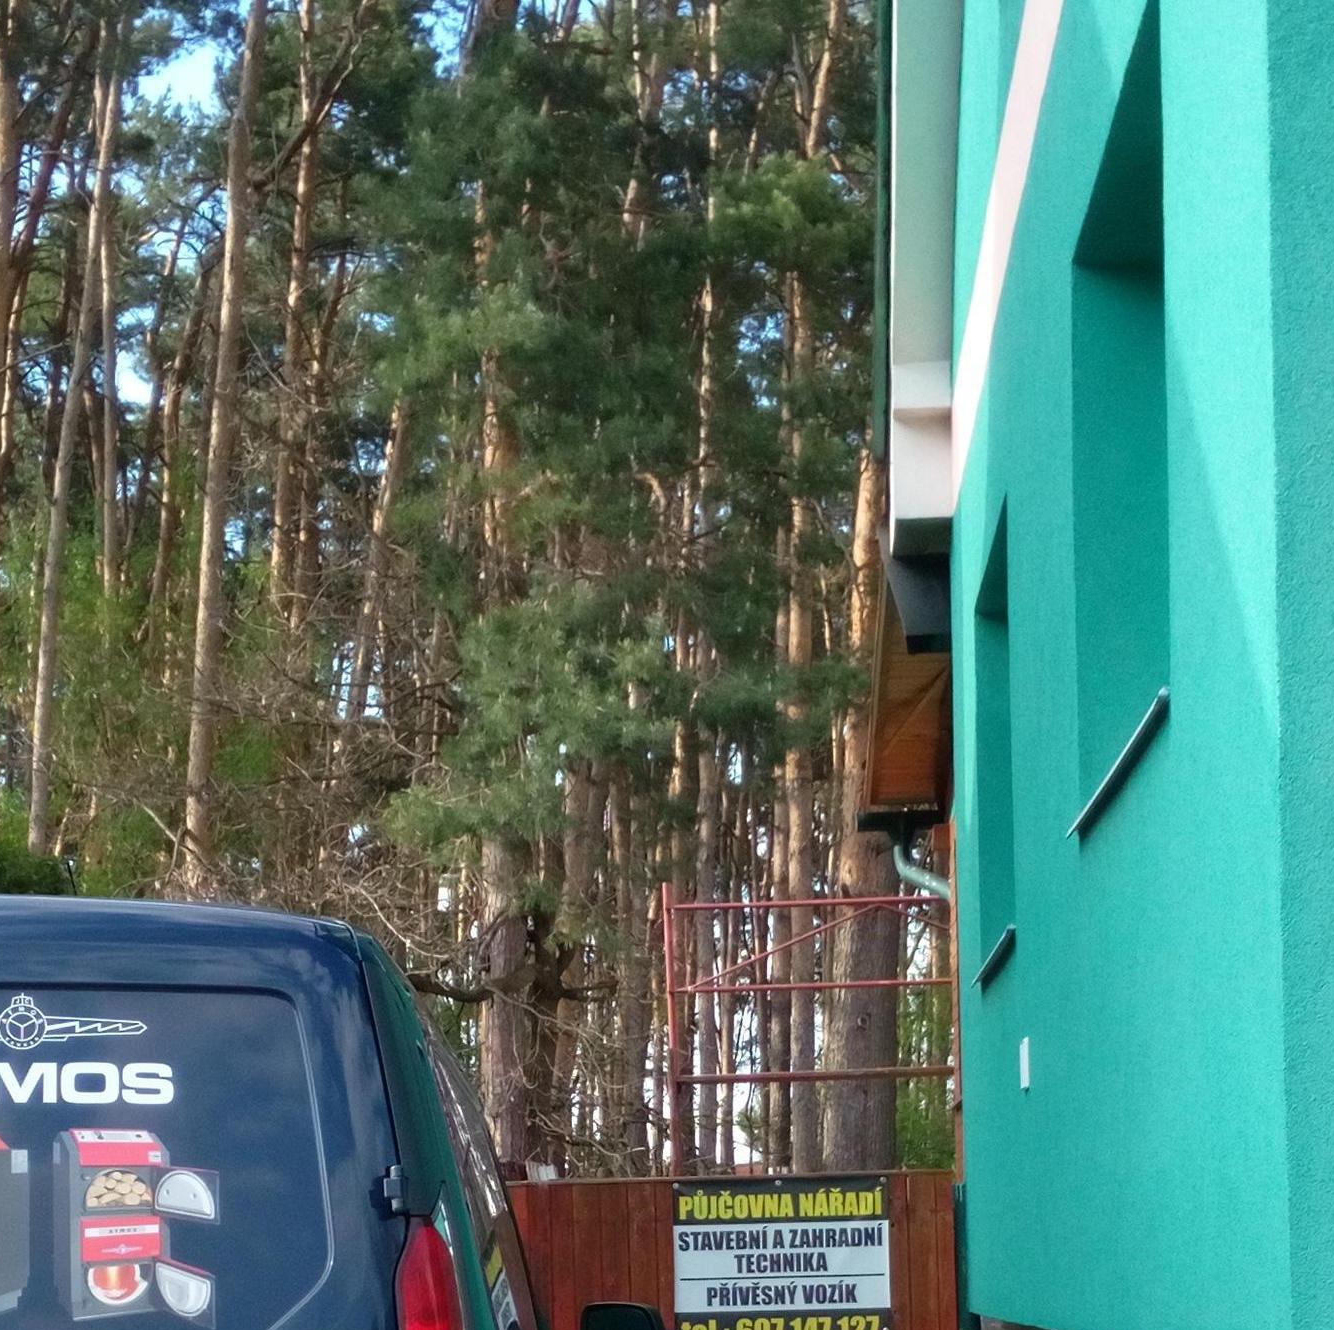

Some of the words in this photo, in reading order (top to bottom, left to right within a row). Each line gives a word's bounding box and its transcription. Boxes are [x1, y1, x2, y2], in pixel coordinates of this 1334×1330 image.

[678, 1189, 794, 1220] PŮJČOVNA
[799, 1187, 884, 1217] NÁŘADÍ
[678, 1226, 768, 1251] STAVEBNÍ
[772, 1229, 785, 1250] A
[789, 1223, 884, 1249] ZAHRADNÍ
[734, 1252, 828, 1274] TECHNIKA
[706, 1281, 797, 1307] PŘÍVĚSNÝ
[801, 1280, 858, 1304] VOZÍK
